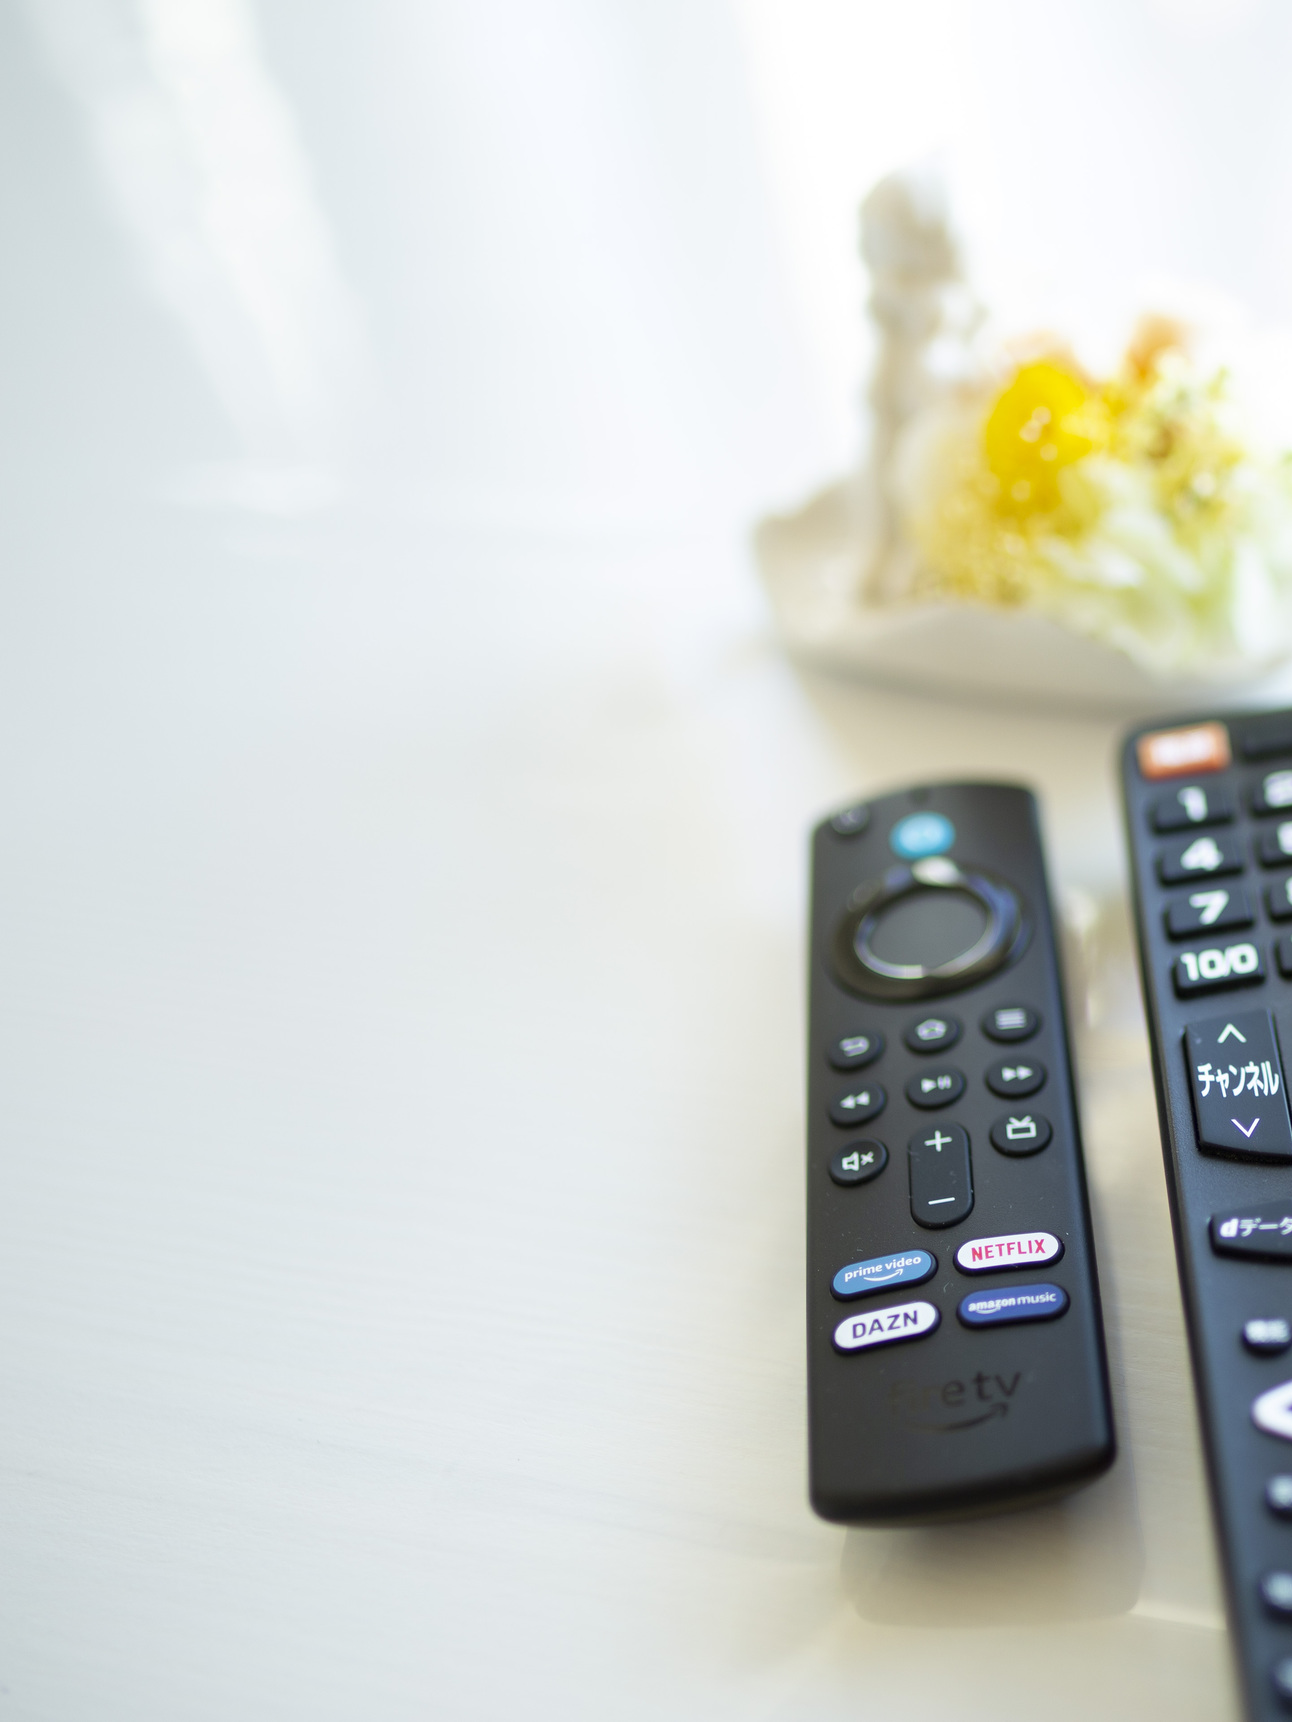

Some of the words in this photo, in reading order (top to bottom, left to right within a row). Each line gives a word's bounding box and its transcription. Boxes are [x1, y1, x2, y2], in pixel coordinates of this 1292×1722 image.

[1180, 837, 1223, 870] 4
[1189, 890, 1229, 925] 7
[1180, 943, 1259, 981] 10/0
[1197, 1060, 1280, 1098] チャンネル
[970, 1238, 1047, 1263] NETFLIX
[843, 1264, 883, 1283] prime
[884, 1254, 923, 1272] video
[967, 1297, 1016, 1313] amazon
[1016, 1291, 1057, 1306] music
[851, 1309, 919, 1340] DAZN
